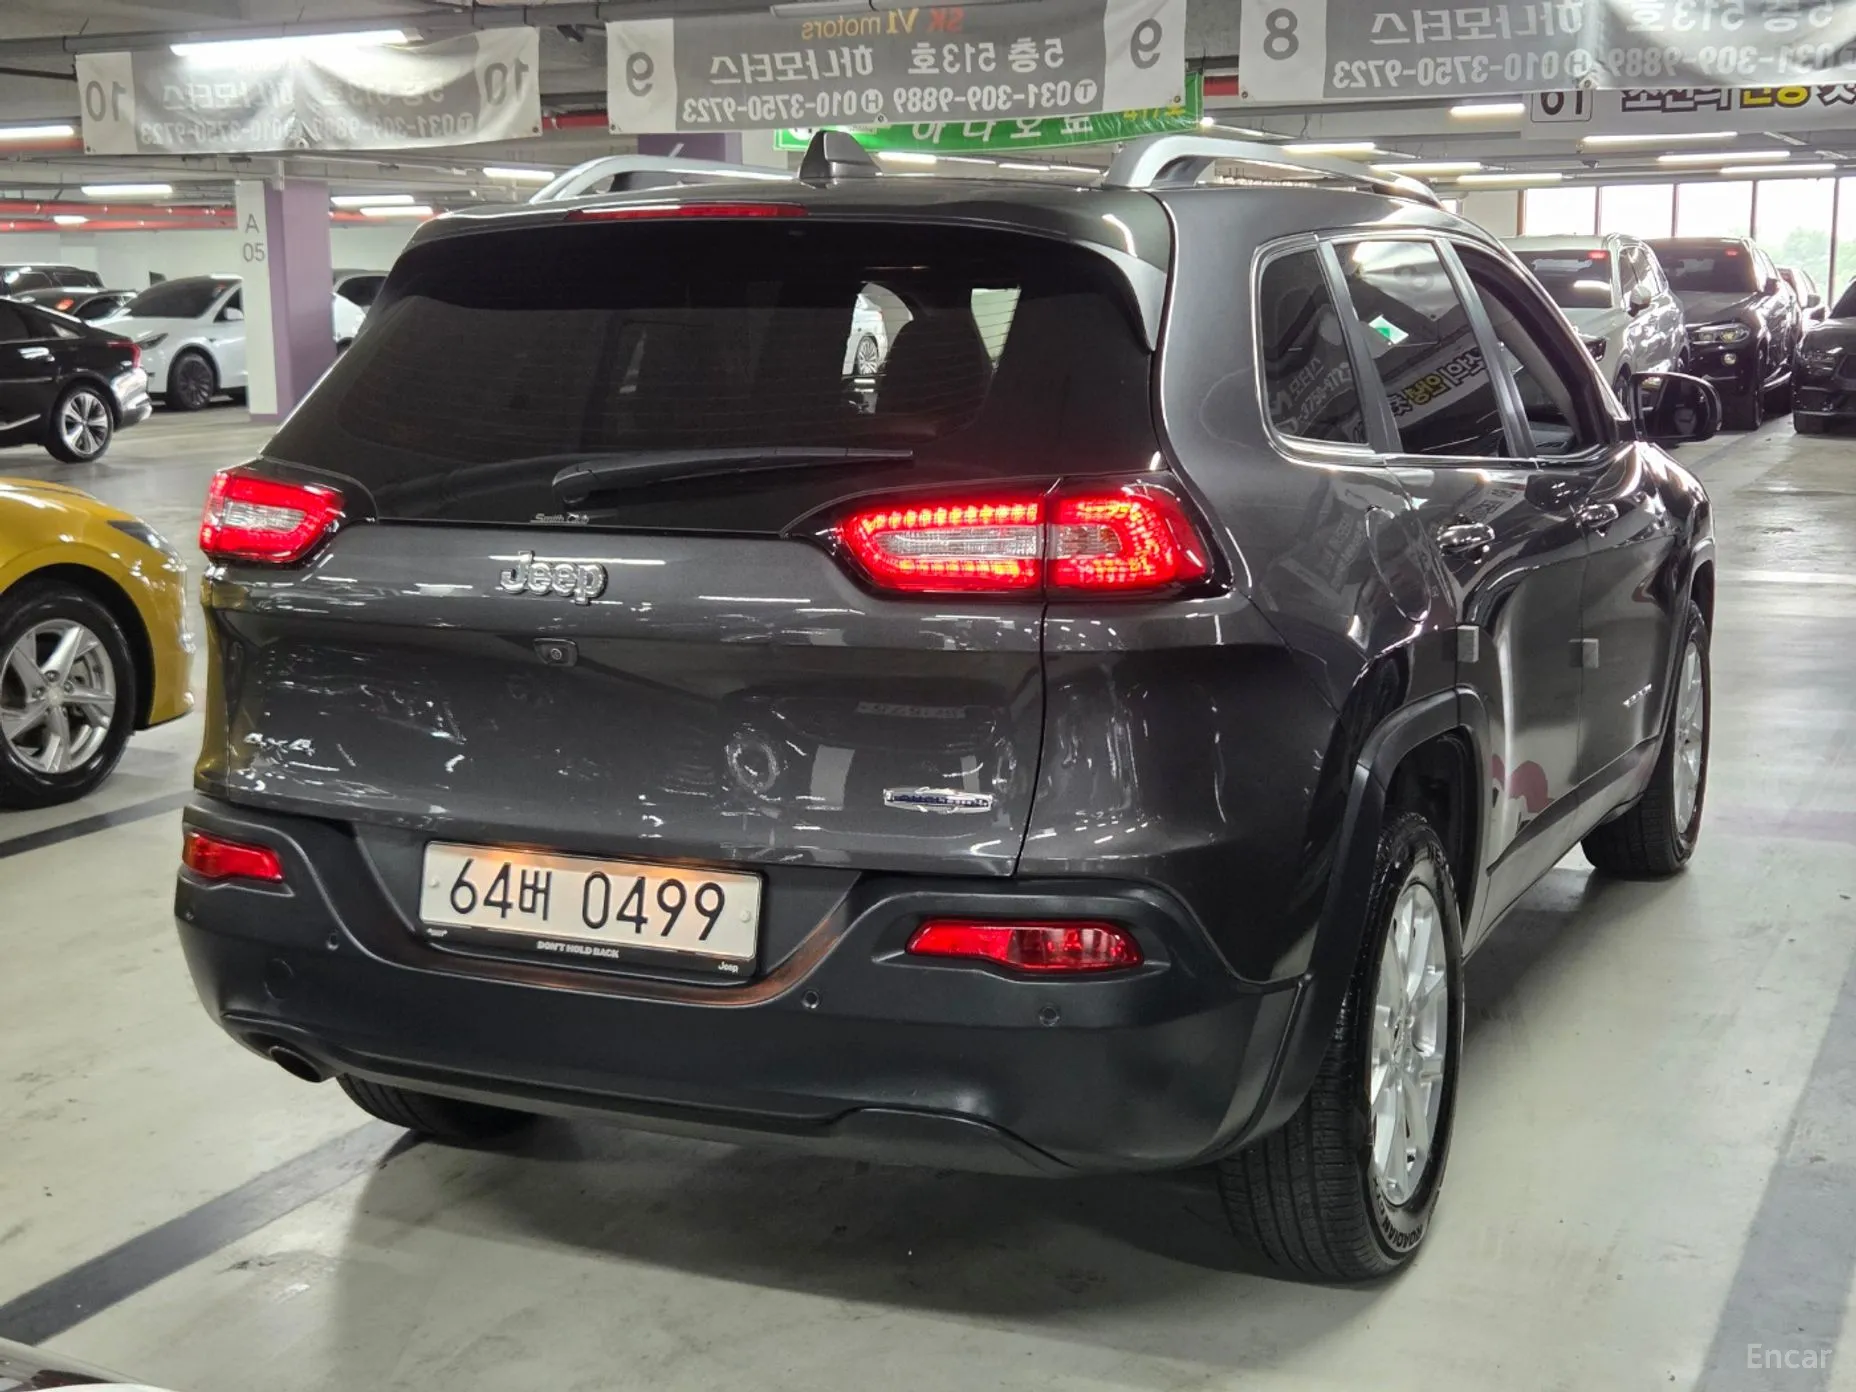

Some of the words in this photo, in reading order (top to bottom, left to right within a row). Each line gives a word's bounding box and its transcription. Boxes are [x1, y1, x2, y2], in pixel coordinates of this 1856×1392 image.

[245, 213, 260, 233] A
[242, 242, 265, 262] 05
[500, 550, 608, 607] Jeep
[450, 858, 552, 921] 64버
[582, 871, 726, 941] 0499
[566, 943, 593, 955] HOLD
[593, 947, 619, 959] BACK
[718, 961, 739, 973] Jeep
